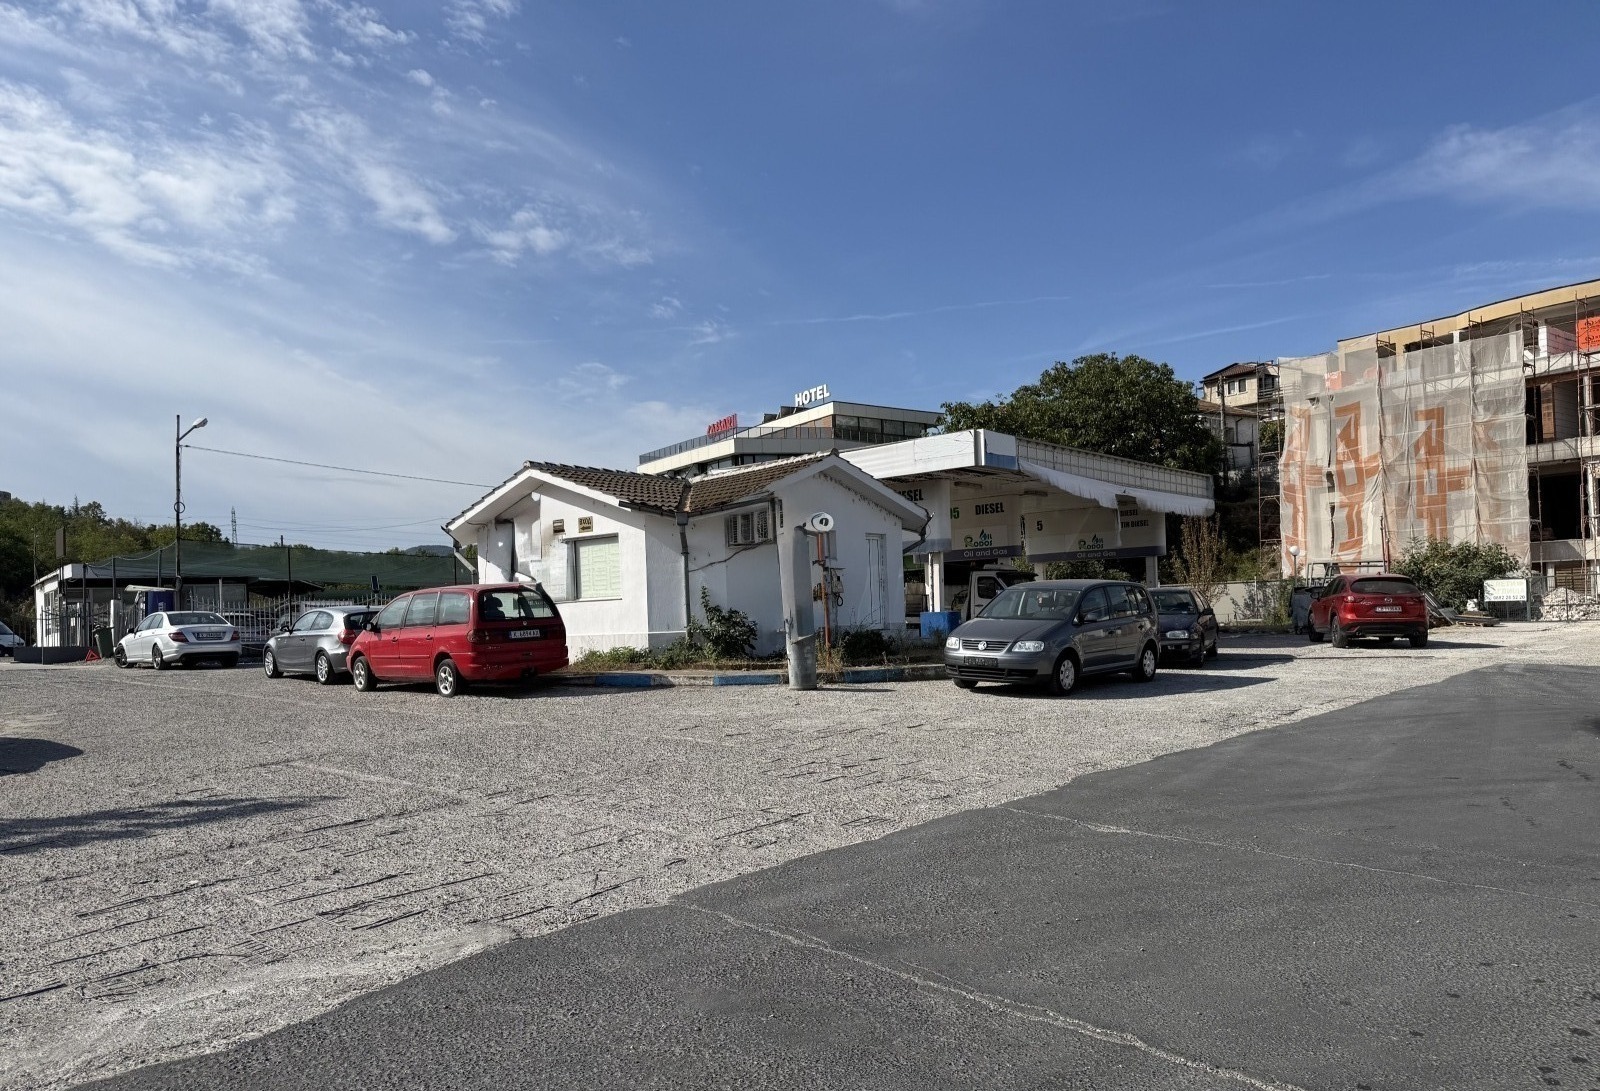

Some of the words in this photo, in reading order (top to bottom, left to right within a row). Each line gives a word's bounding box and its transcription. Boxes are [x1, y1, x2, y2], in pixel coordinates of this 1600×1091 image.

[794, 383, 830, 407] HOTEL
[975, 502, 1004, 515] DIESEL
[963, 550, 974, 558] Oil
[976, 549, 990, 557] and
[992, 548, 1008, 556] Gas
